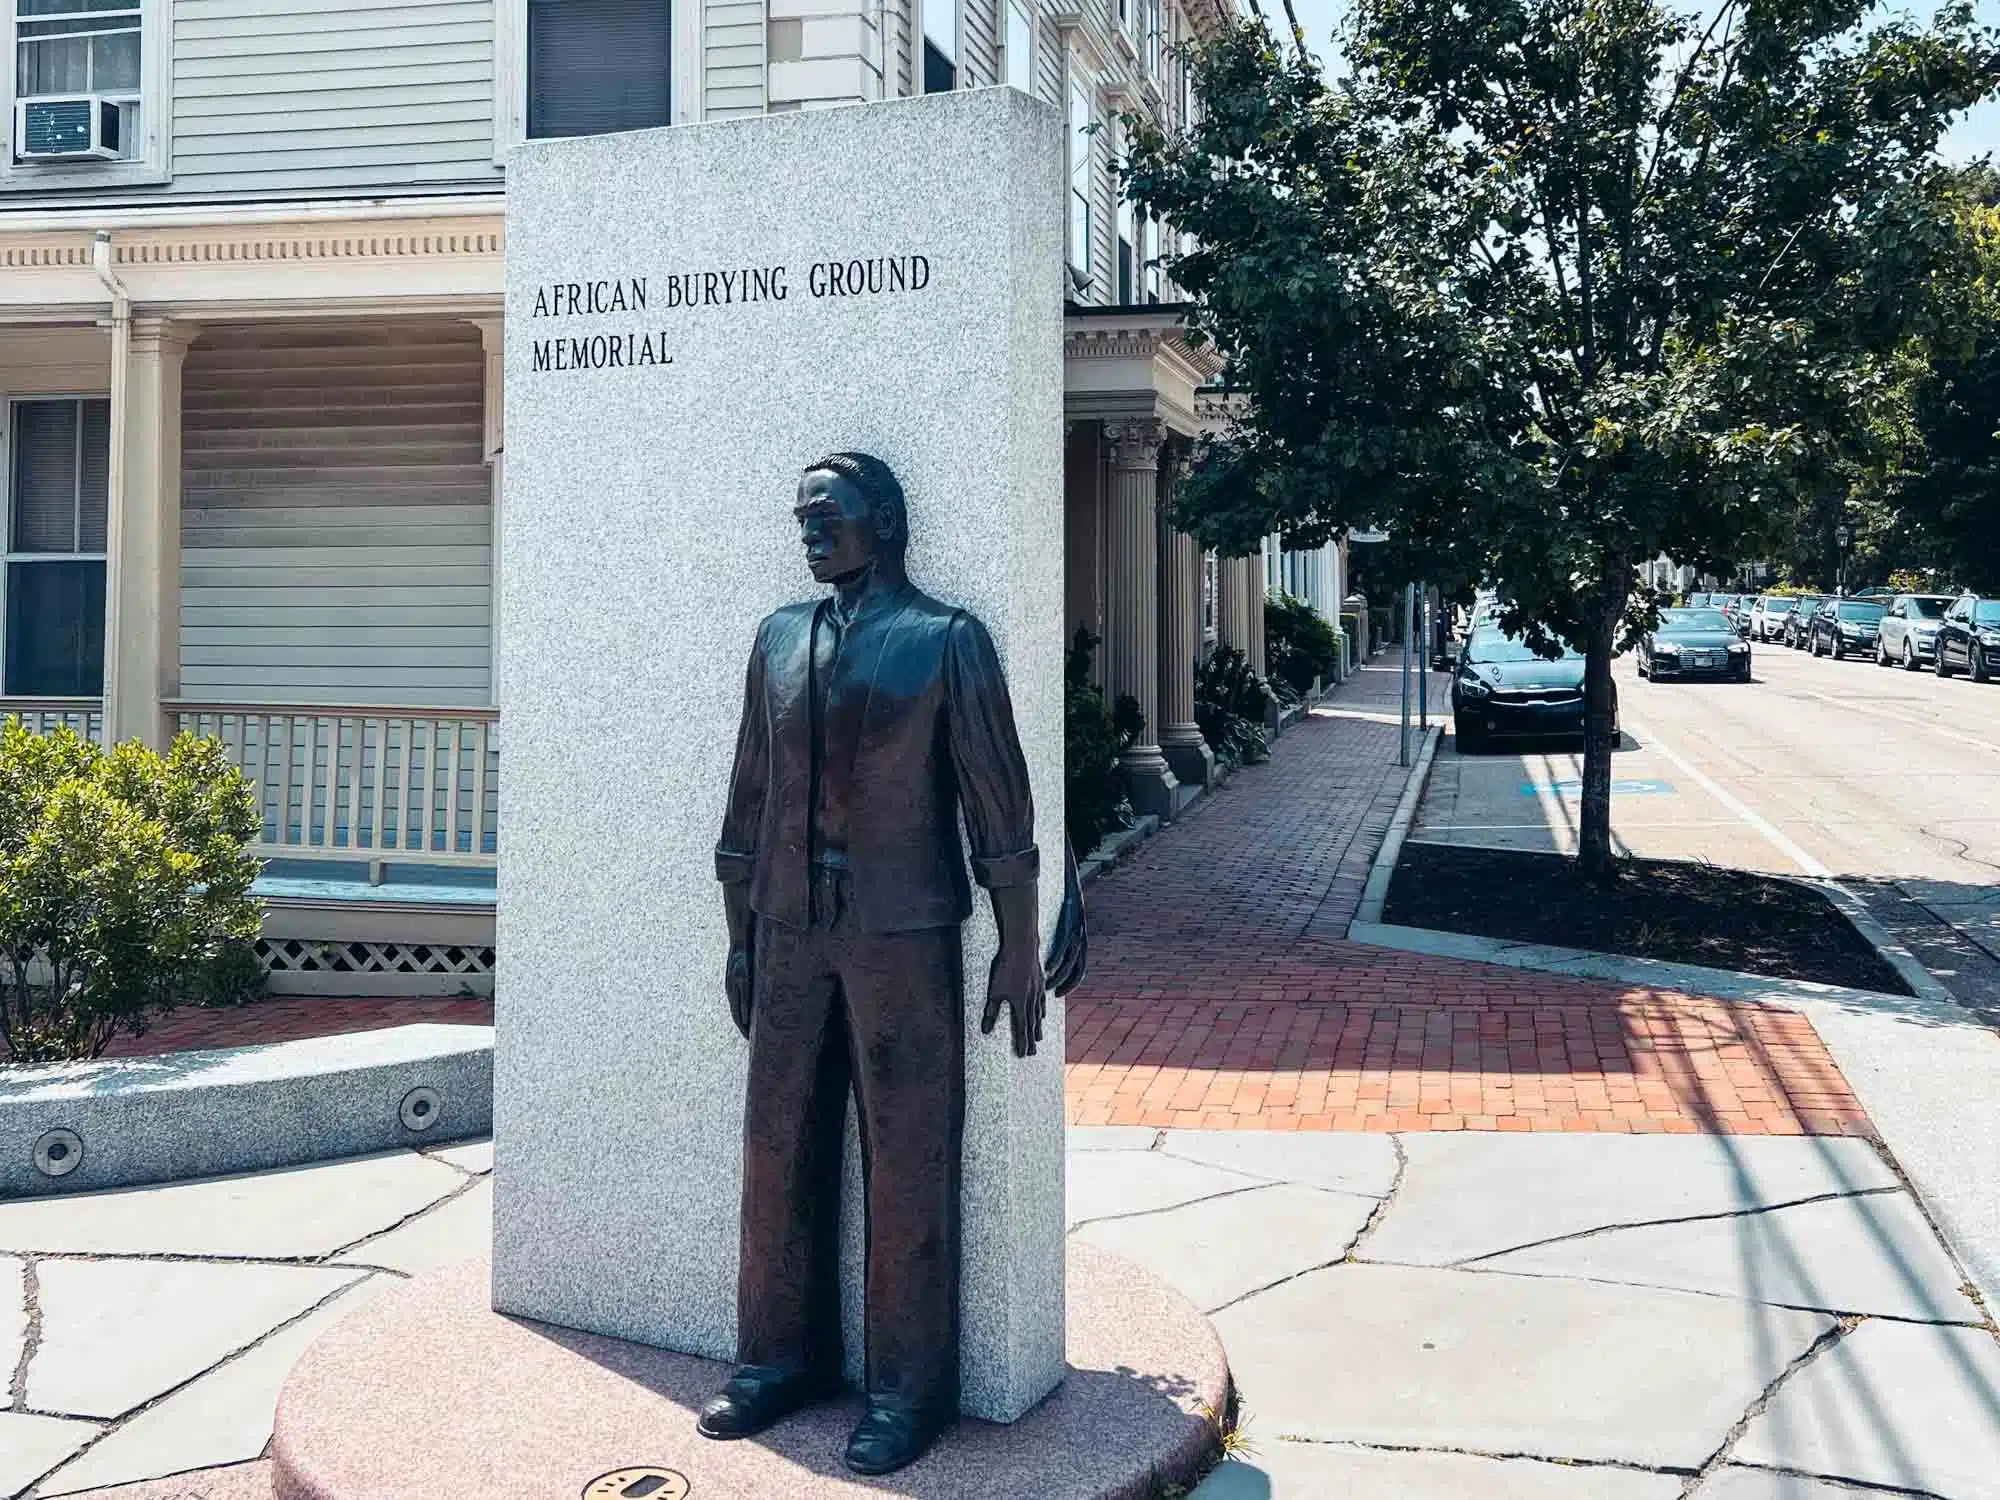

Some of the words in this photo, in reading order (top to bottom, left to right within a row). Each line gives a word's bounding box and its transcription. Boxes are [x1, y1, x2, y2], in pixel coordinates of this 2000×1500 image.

[533, 278, 647, 317] AFRICAN
[667, 266, 788, 308] BURYING
[809, 255, 930, 298] GROUND
[532, 332, 673, 371] MEMORIAL
